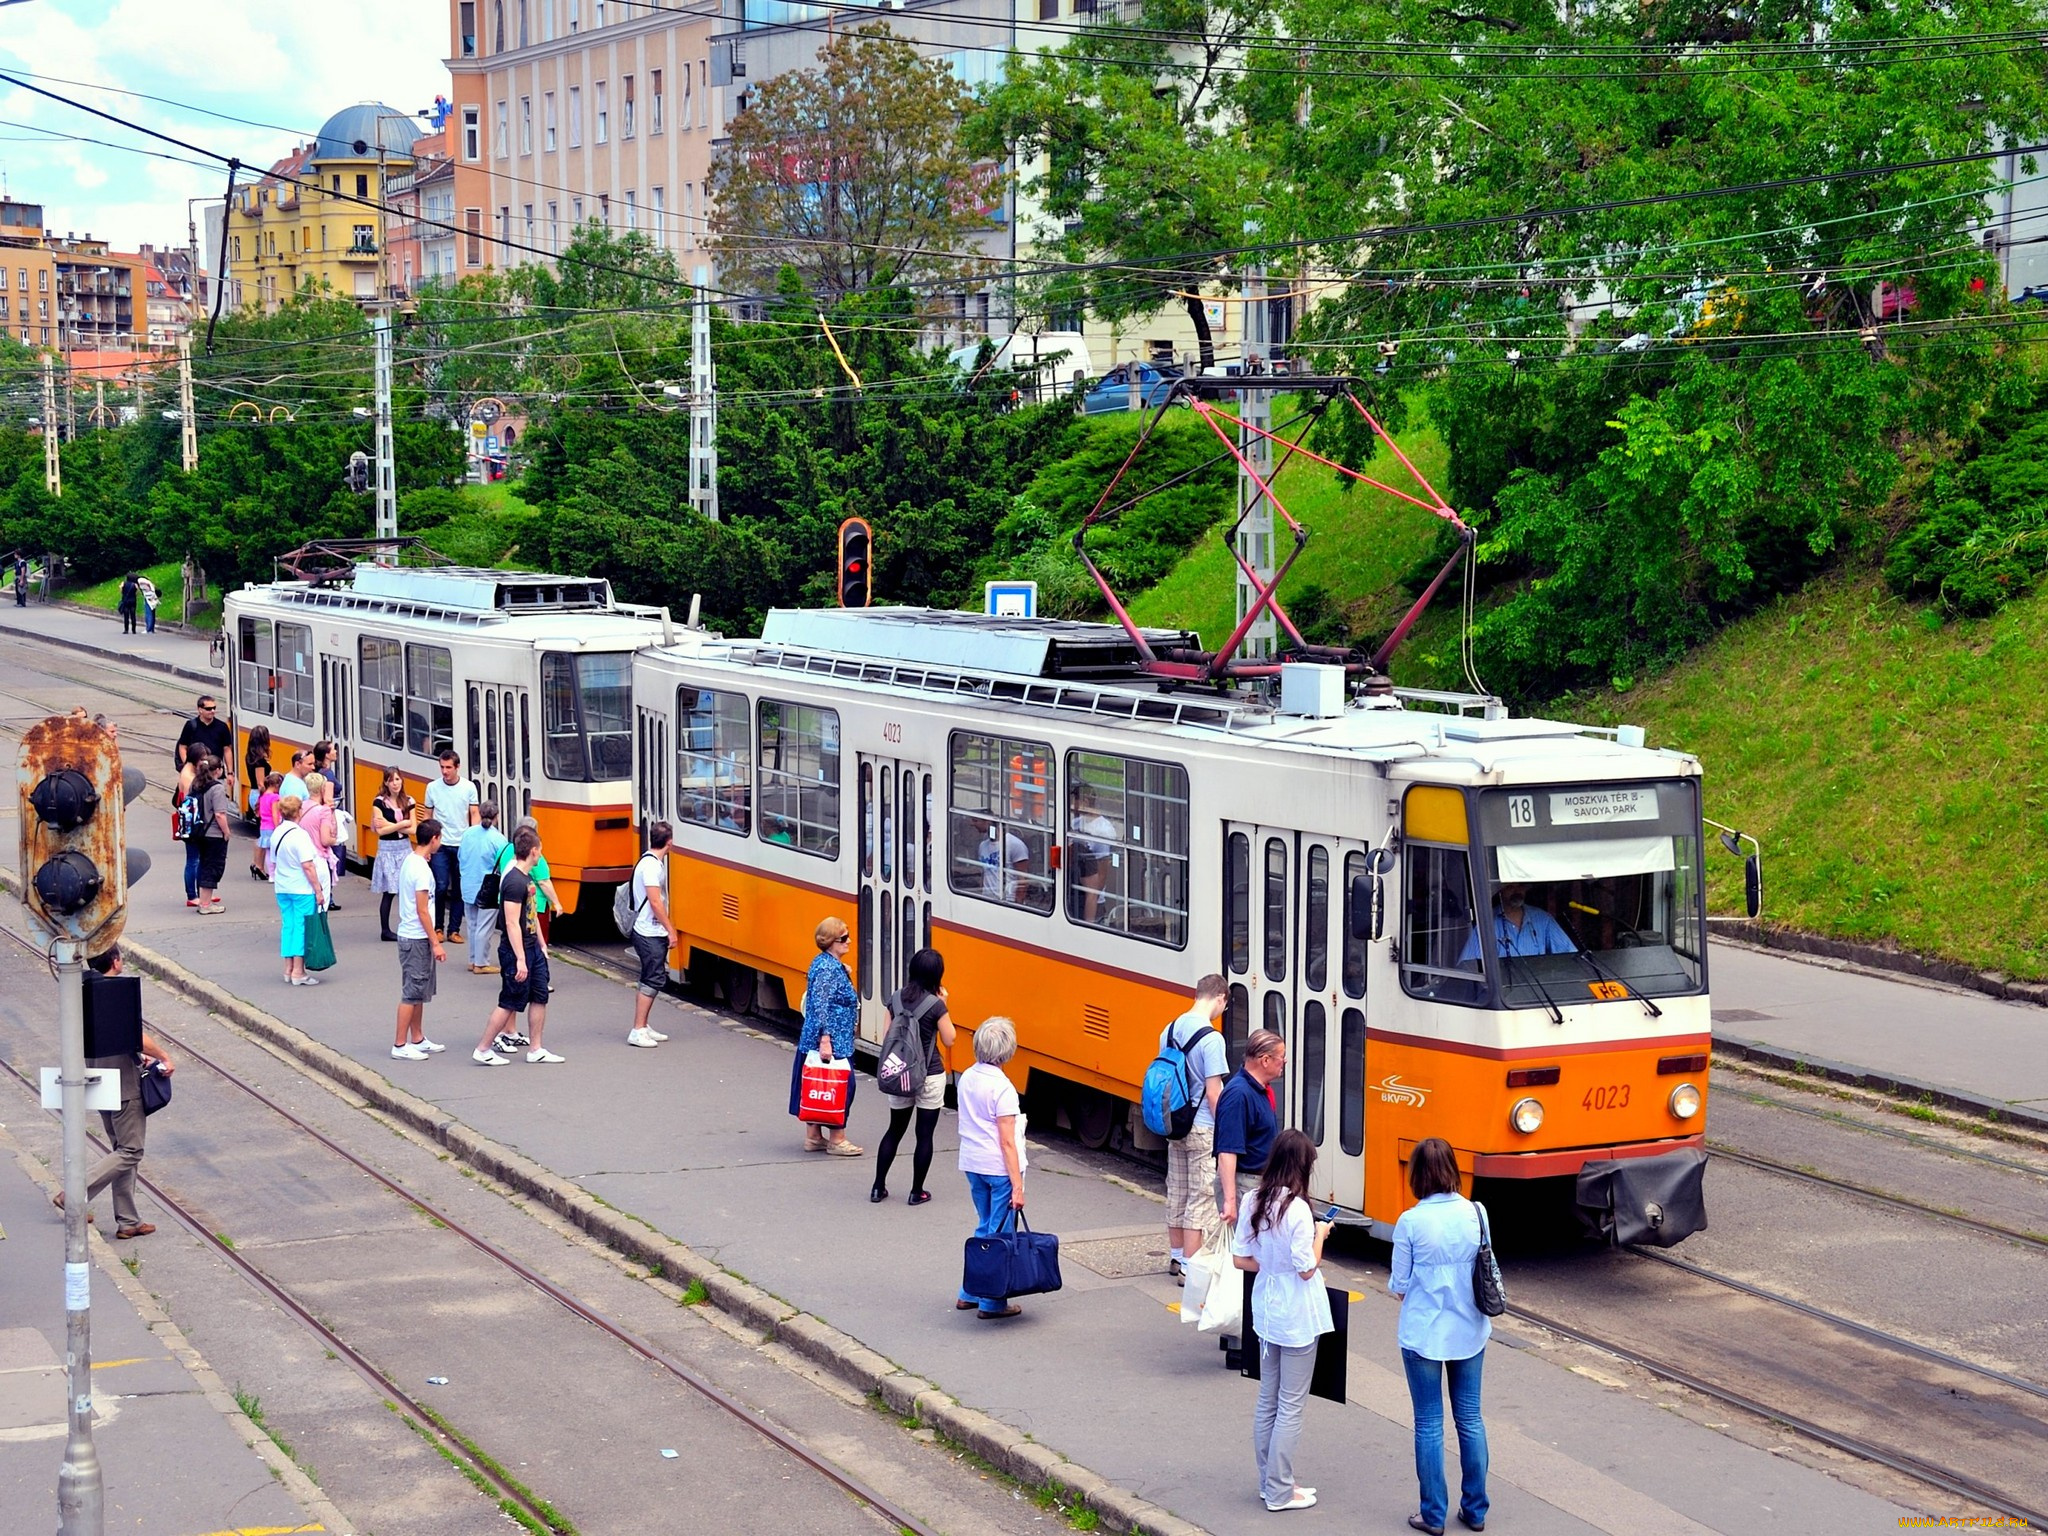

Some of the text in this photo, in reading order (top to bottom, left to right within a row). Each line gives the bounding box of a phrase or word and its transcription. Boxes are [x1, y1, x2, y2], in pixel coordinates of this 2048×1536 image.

[883, 721, 902, 743] 4023
[1564, 795, 1609, 806] MOSZKVA
[1610, 792, 1629, 803] TÉR
[1511, 798, 1532, 824] 18
[1574, 804, 1637, 817] SAVOYA PARK
[1582, 1084, 1631, 1111] 4023
